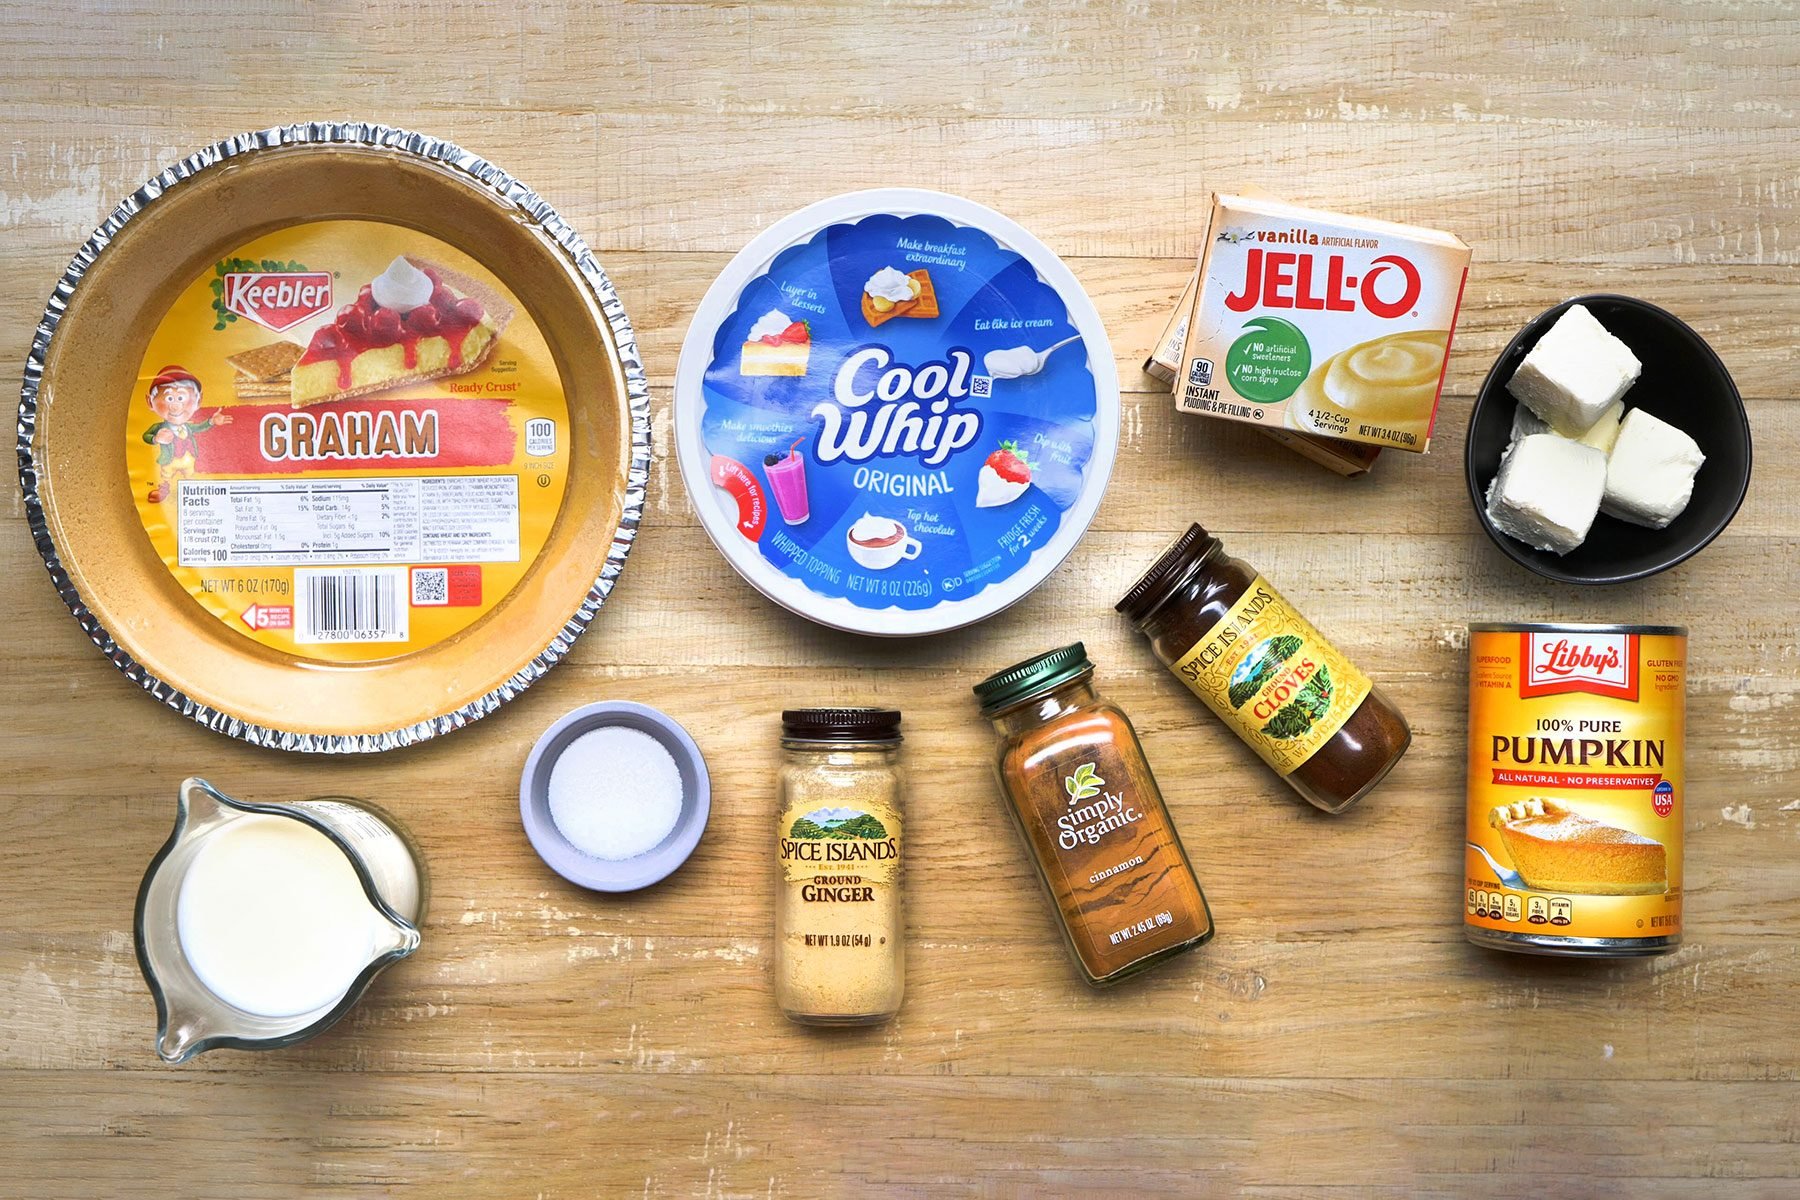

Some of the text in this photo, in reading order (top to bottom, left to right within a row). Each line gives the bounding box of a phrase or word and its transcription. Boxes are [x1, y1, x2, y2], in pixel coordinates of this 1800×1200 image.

[897, 237, 966, 256] Make breakfast
[1257, 228, 1379, 249] vanilla ARTIFICIAL FLAVOR
[905, 253, 966, 272] extraordinary
[229, 274, 330, 311] Keebler
[780, 281, 817, 300] Layer in
[792, 297, 827, 315] desserts
[975, 318, 1054, 330] Eat like ice cream
[1253, 343, 1296, 354] NO artificial
[1252, 353, 1291, 362] sweeteners
[1196, 361, 1208, 373] 90
[1242, 365, 1302, 376] NO high fructose
[834, 347, 970, 407] Cool
[1259, 375, 1278, 386] syrup
[450, 382, 516, 394] Ready Crust
[1185, 386, 1220, 400] INSTANT
[1184, 397, 1251, 418] PUDDING & PIE FILLING
[1308, 409, 1350, 425] 4 1/2-Cup
[263, 410, 437, 458] GRAHAM
[531, 423, 550, 436] 100
[721, 419, 793, 433] Make smoothies
[811, 397, 979, 465] Whip
[1313, 419, 1348, 433] Servings
[736, 433, 777, 443] delicious
[1033, 432, 1072, 452] Dip with
[1358, 425, 1417, 446] NET WT 3.4 OZ (96g)
[1051, 452, 1072, 465] fruit
[183, 486, 226, 495] Nutrition
[853, 466, 954, 498] ORIGINAL
[183, 497, 210, 506] Facts
[725, 462, 760, 525] Lift here for recipes
[906, 508, 939, 522] Top hot
[183, 527, 206, 535] Serving
[914, 524, 956, 536] chocolate
[997, 504, 1041, 548] FRIDGE FRESH
[1008, 515, 1048, 557] for 2 weeks
[212, 549, 227, 561] 100
[770, 529, 842, 585] WHIPPED TOPPING
[201, 579, 289, 595] NET WT 6 OZ (170g)
[846, 574, 932, 598] NET WT 8 OZ (226g)
[257, 609, 269, 627] 5
[318, 629, 386, 640] 27800 06357
[1180, 587, 1273, 682] SPICE ISLANDS
[1535, 639, 1619, 675] Libby's
[1252, 657, 1316, 721] CLOVES
[1261, 667, 1292, 697] GROUND
[1536, 719, 1622, 733] 100% PURE
[1292, 744, 1308, 758] WT
[1491, 735, 1665, 768] PUMPKIN
[1498, 773, 1559, 784] ALL NATURAL
[1567, 776, 1654, 786] NO PRESERVATIVES
[1655, 795, 1672, 805] USA
[1057, 791, 1124, 832] Simply
[781, 838, 896, 861] SPICE ISLANDS
[1089, 855, 1144, 884] cinnamon
[814, 875, 861, 884] GROUND
[801, 884, 875, 902] GINGER
[1109, 931, 1122, 945] NET
[1132, 921, 1147, 936] 2.45
[1155, 910, 1172, 927] (69g)
[805, 934, 817, 946] NET
[818, 935, 828, 946] WT
[830, 935, 840, 946] 1.9
[842, 935, 850, 946] OZ
